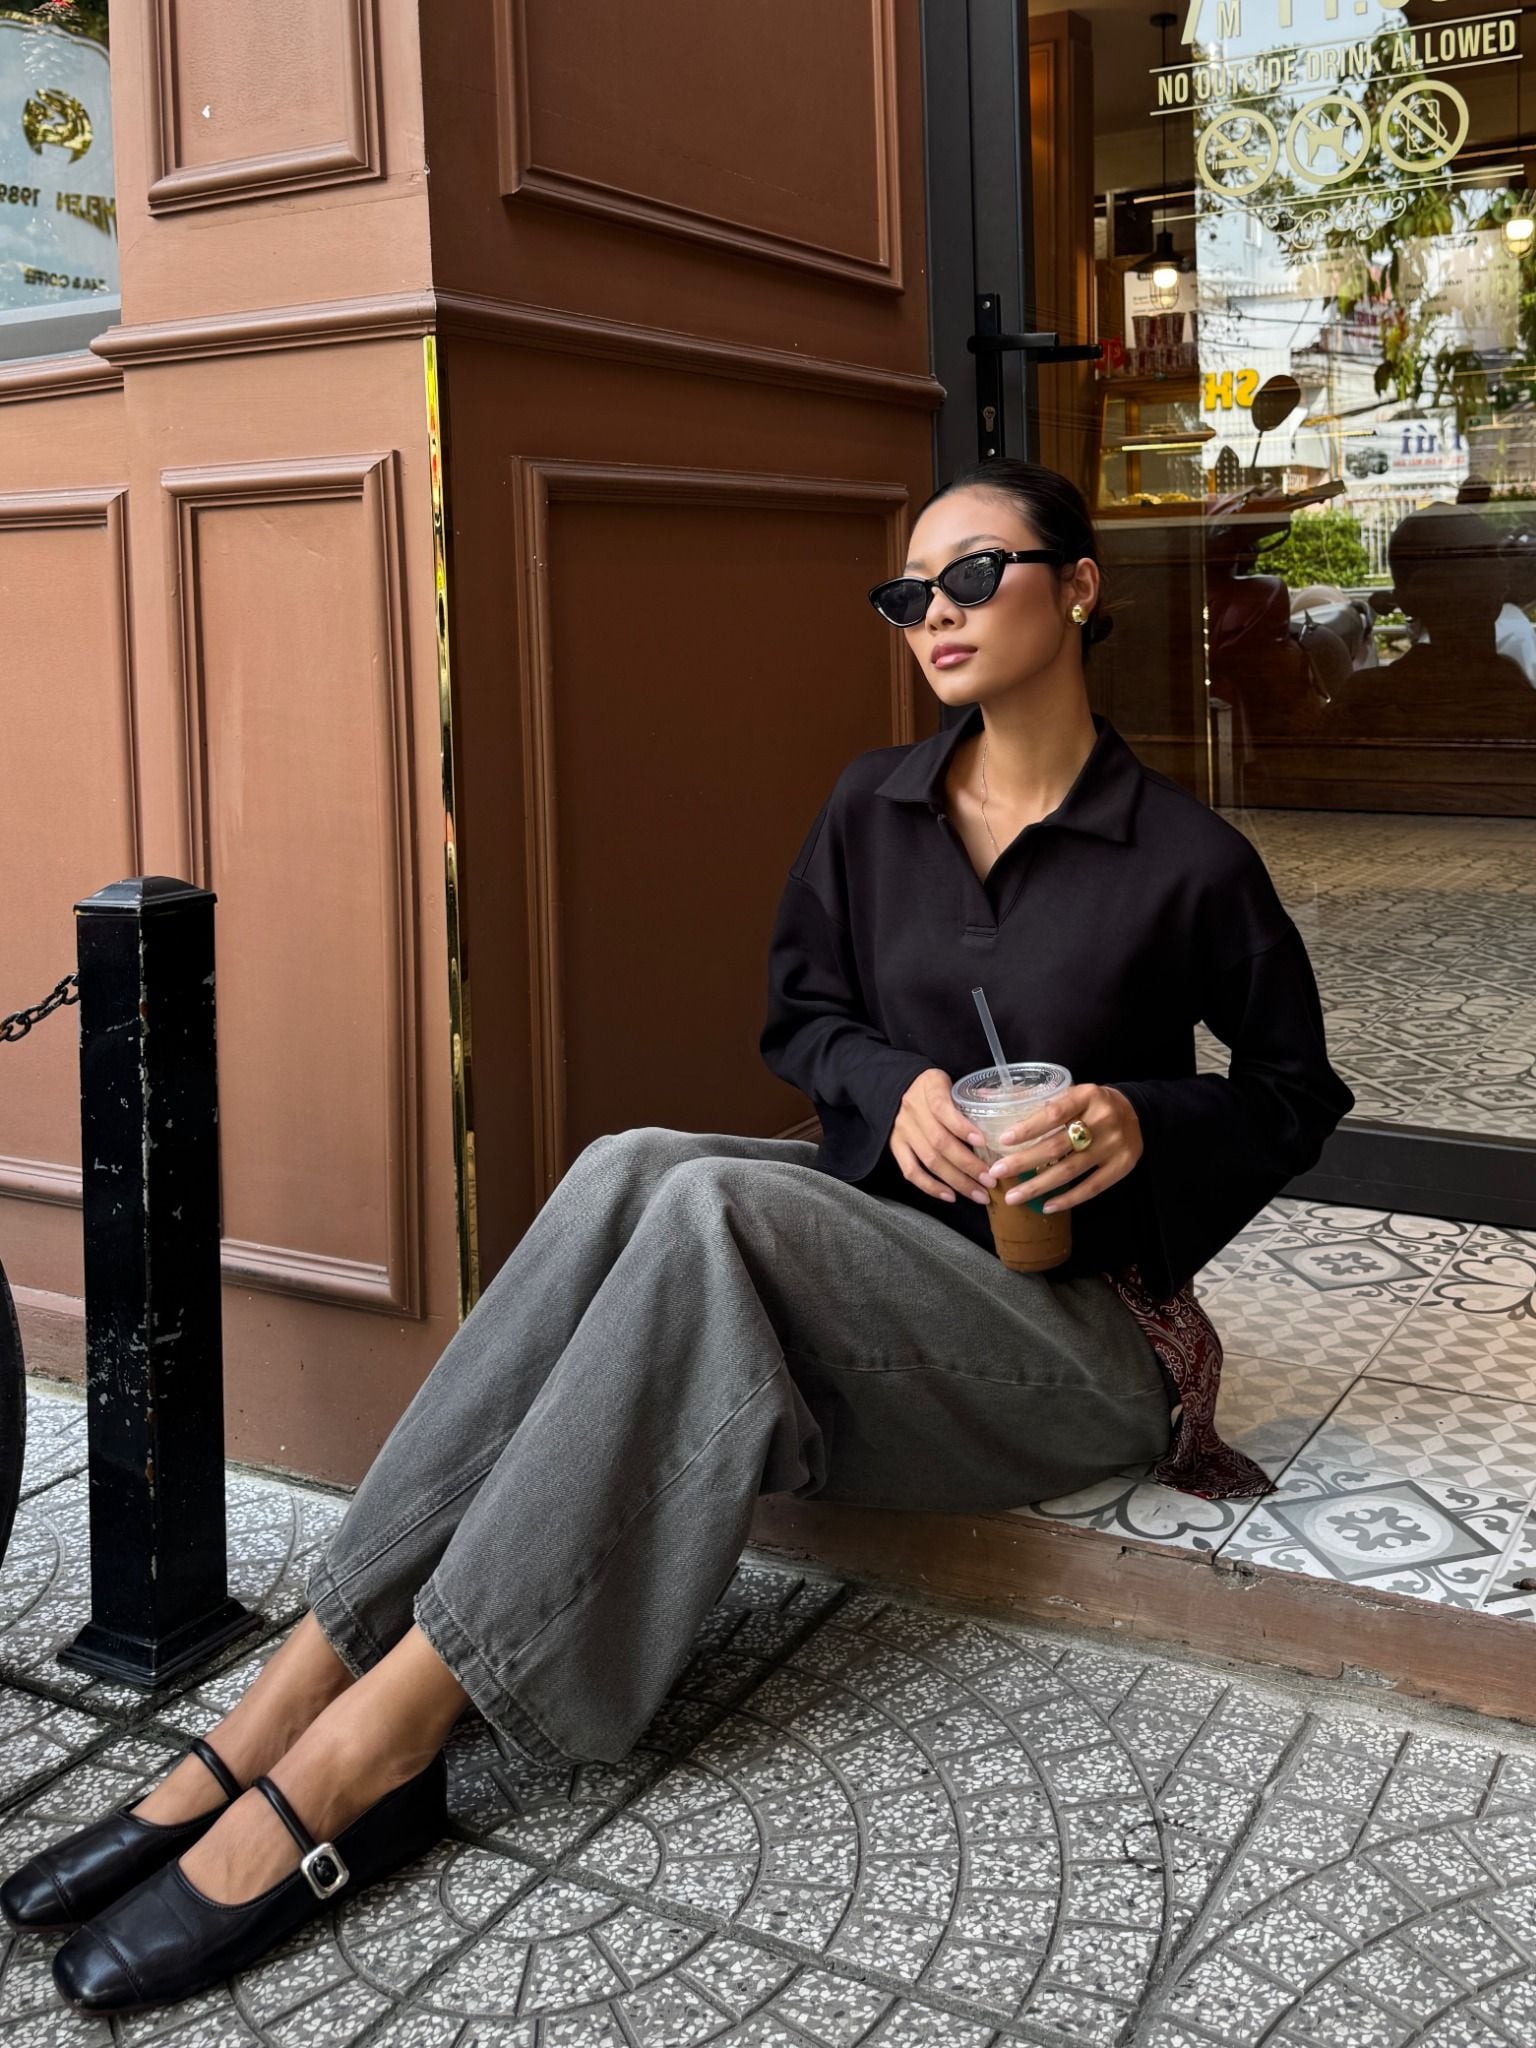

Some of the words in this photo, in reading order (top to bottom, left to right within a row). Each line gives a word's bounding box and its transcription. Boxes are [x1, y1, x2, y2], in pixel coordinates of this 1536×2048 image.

[1158, 72, 1189, 106] NO
[1197, 53, 1297, 100] OUTSIDE
[1306, 43, 1382, 82] DRINK
[1391, 19, 1516, 69] ALLOWED
